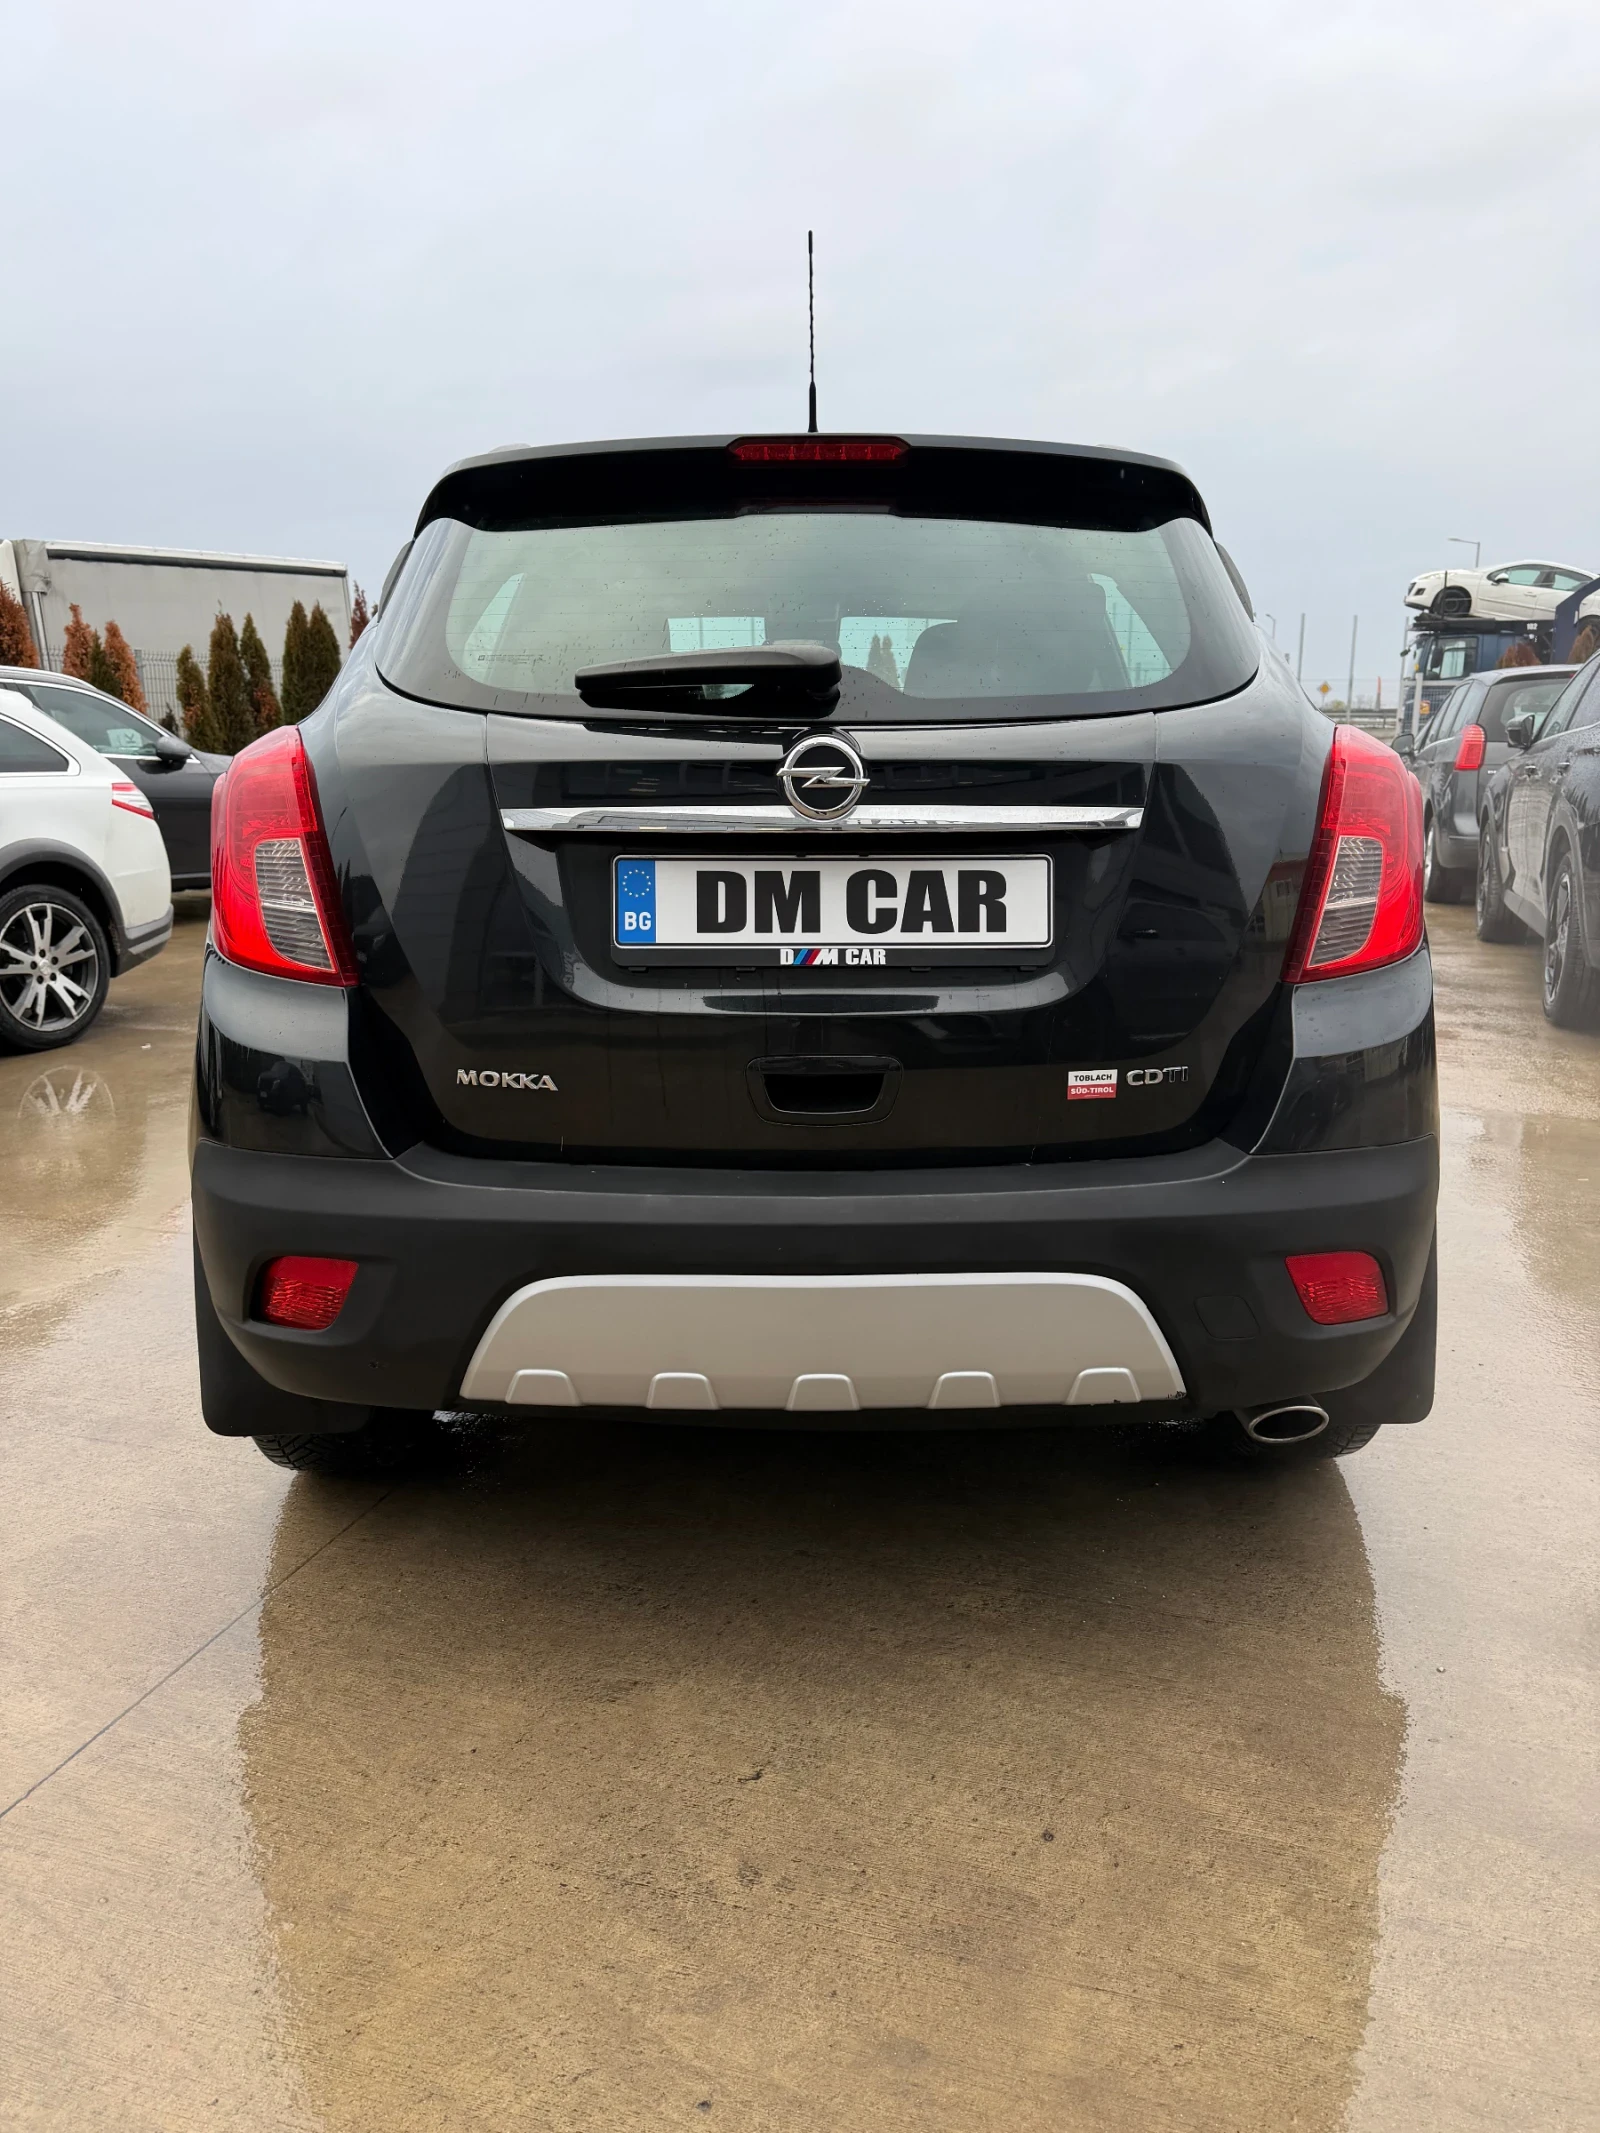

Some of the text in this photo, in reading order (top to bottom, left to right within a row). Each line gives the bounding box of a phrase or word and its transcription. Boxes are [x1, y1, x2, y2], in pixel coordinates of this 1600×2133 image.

[696, 869, 1007, 934] DM CAR
[624, 911, 652, 931] BG
[845, 948, 886, 965] CAR
[456, 1068, 559, 1091] MOKKA
[1074, 1073, 1113, 1082] TOBLACH
[1126, 1066, 1189, 1086] CDTI
[1070, 1086, 1114, 1095] SÜD-TIROL
